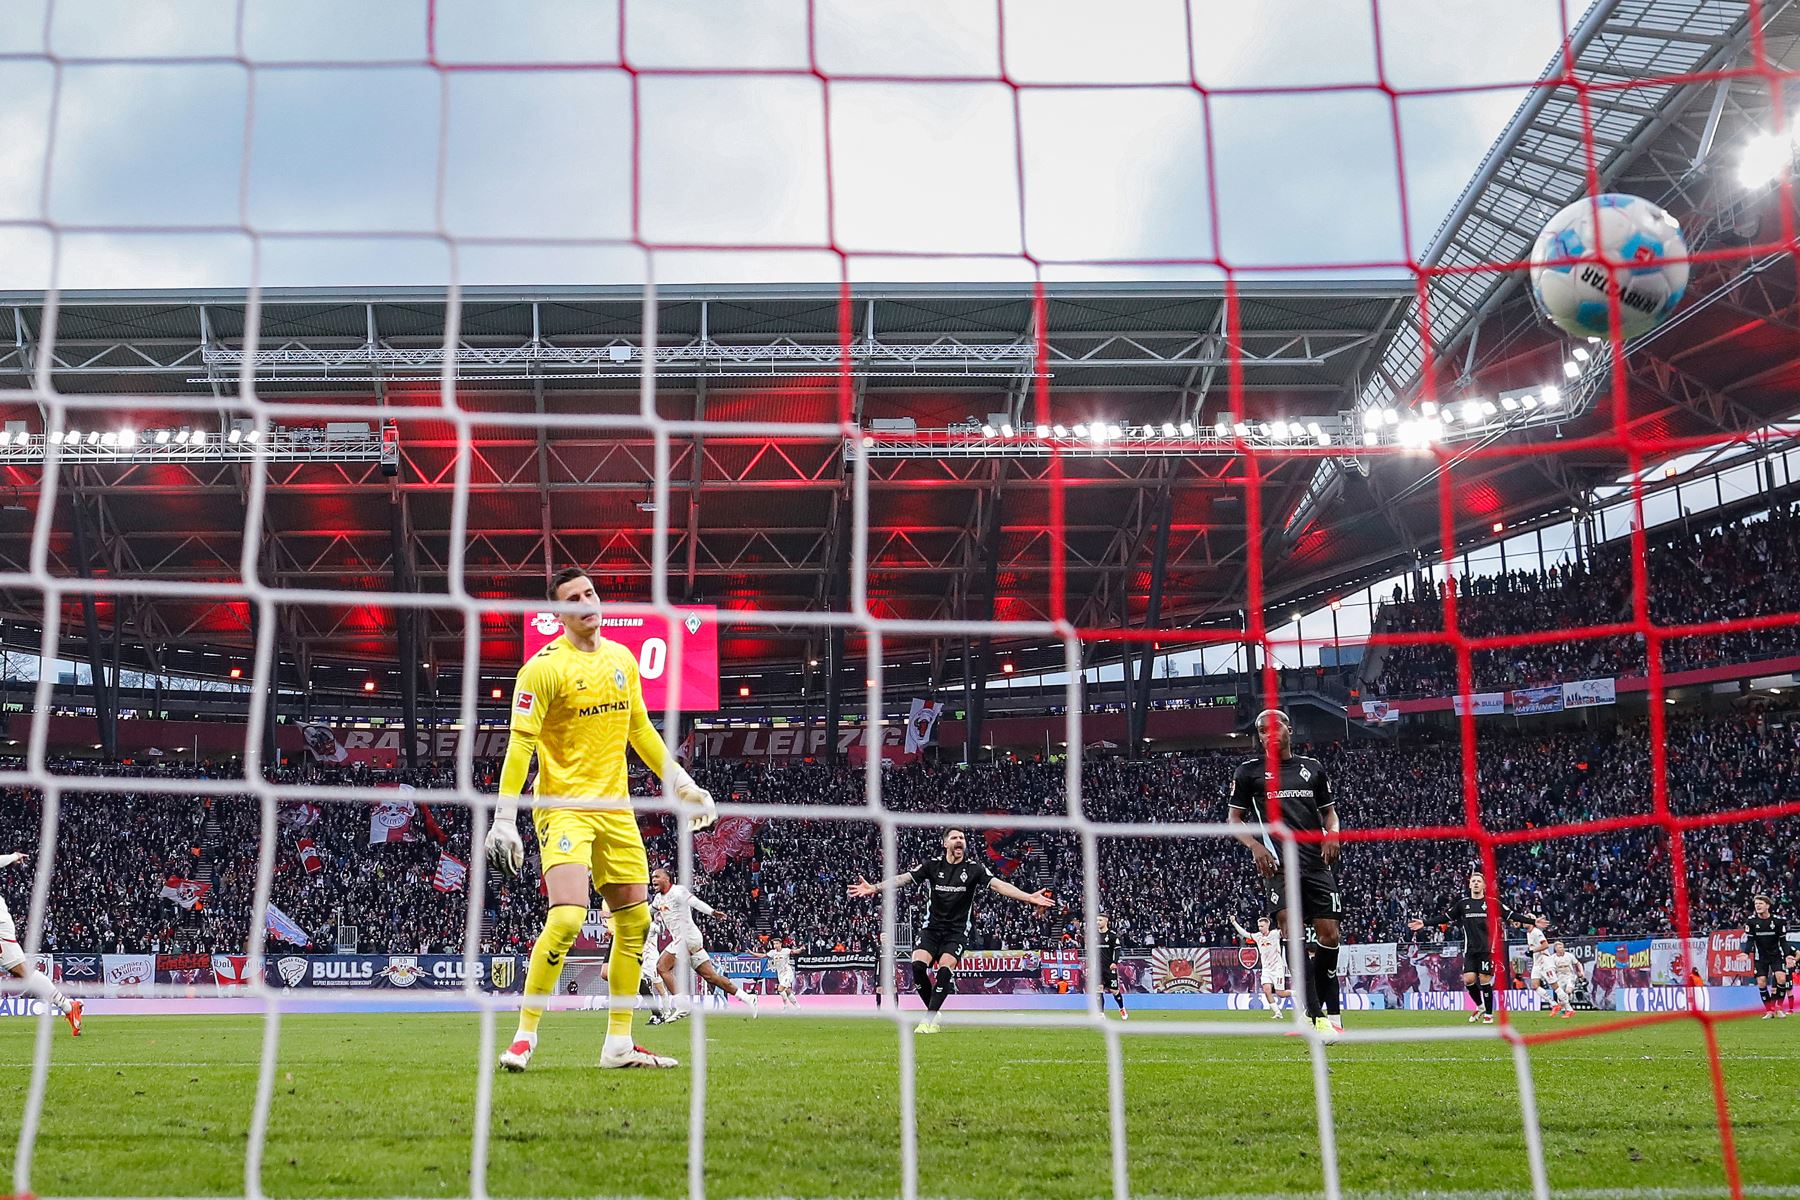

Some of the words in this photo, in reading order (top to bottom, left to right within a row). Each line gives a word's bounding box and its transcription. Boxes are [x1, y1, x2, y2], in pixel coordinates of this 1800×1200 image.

[639, 637, 667, 680] 0
[1330, 893, 1341, 912] 19
[1305, 927, 1317, 943] 32
[955, 944, 963, 956] 3
[1043, 951, 1076, 961] BLOCK
[313, 961, 373, 979] BULLS
[433, 961, 485, 979] CLUB
[721, 961, 761, 973] ELITZSCH
[1482, 961, 1489, 971] 14
[1425, 992, 1455, 1010] RAUCH
[1648, 988, 1695, 1011] RAUCH
